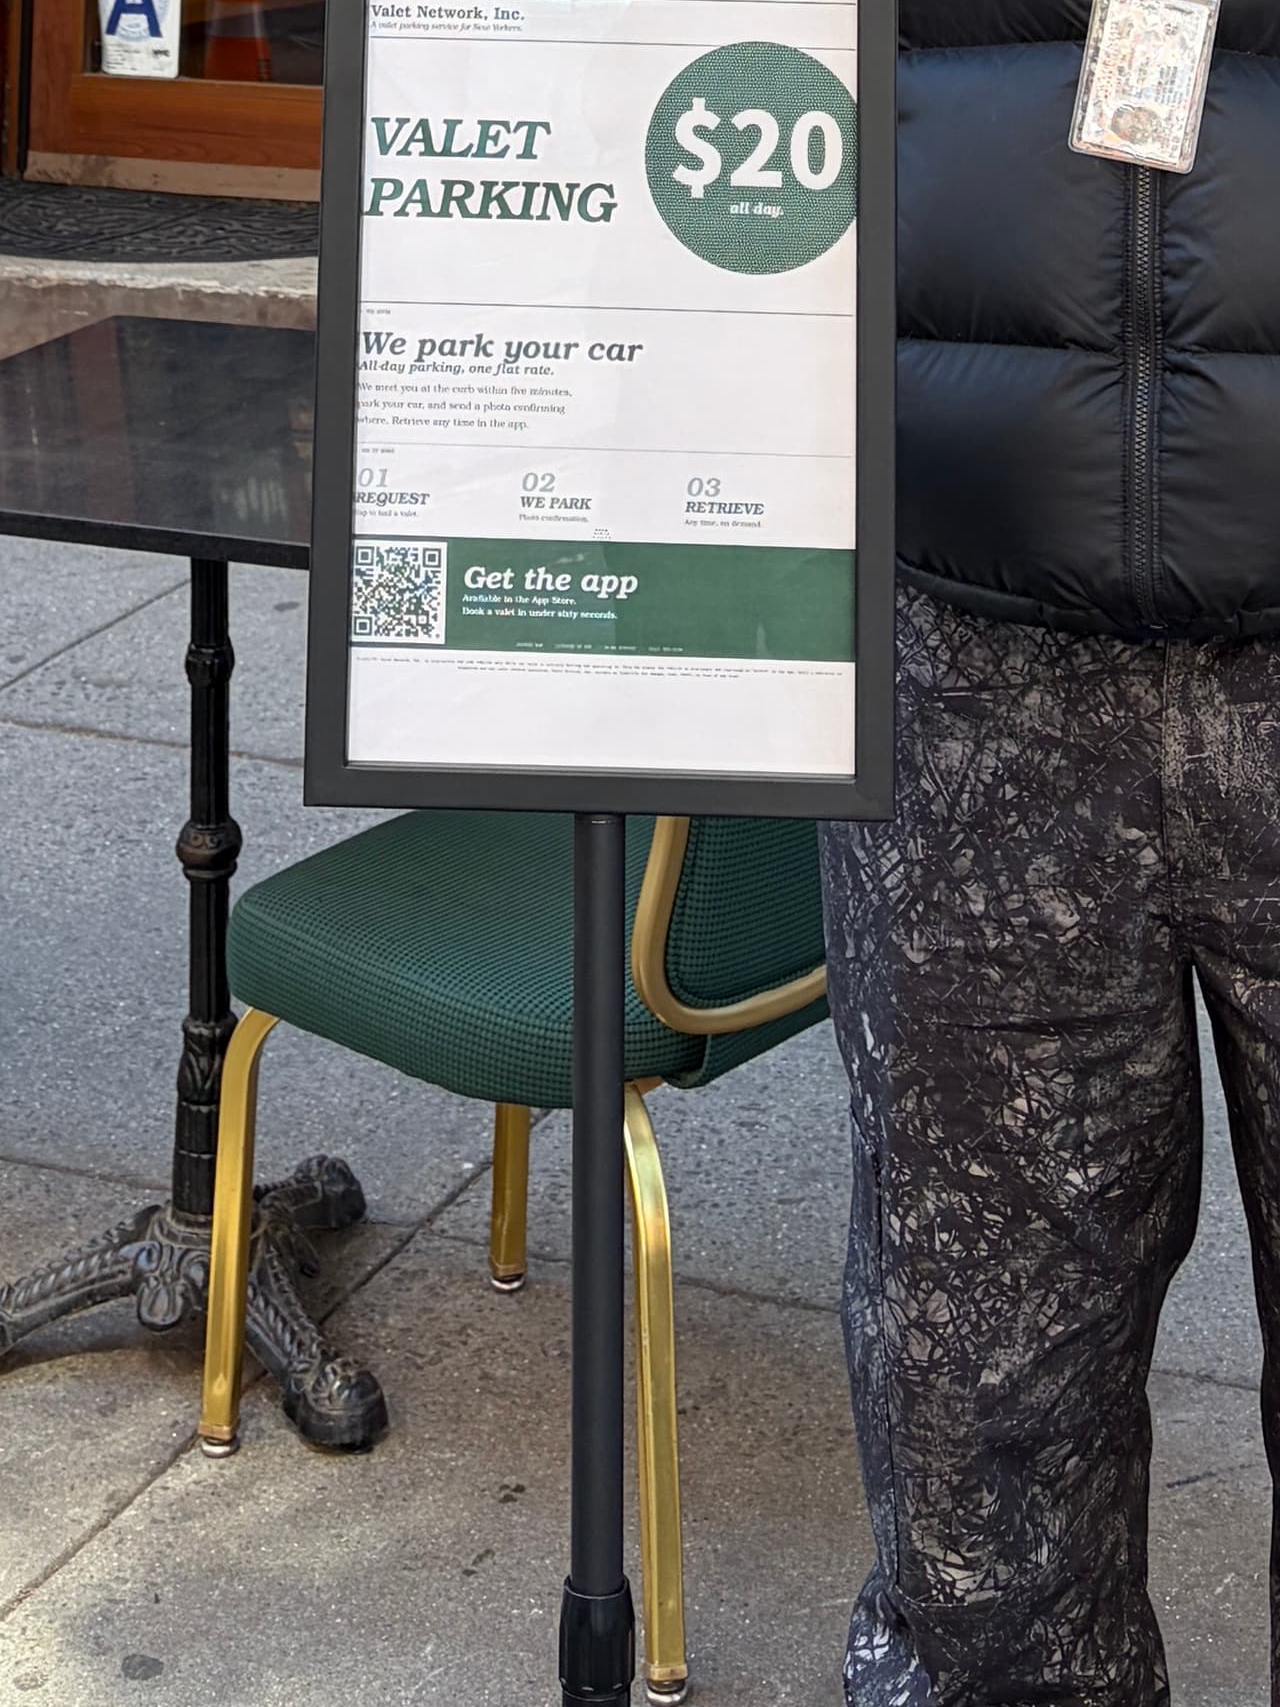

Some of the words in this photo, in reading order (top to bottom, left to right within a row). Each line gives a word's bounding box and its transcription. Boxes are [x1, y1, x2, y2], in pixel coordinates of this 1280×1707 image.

[371, 4, 412, 19] Valet
[417, 5, 489, 21] Network,
[494, 7, 525, 20] Inc.
[371, 117, 552, 160] VALET
[673, 97, 842, 199] $20
[363, 177, 618, 223] PARKING
[730, 200, 751, 216] all
[363, 331, 407, 355] We
[414, 333, 494, 363] park
[503, 339, 580, 365] your
[587, 341, 644, 362] car
[408, 362, 465, 376] parking,
[469, 364, 492, 374] one
[494, 362, 520, 377] flat
[524, 364, 555, 376] rate.
[400, 384, 418, 395] you
[433, 383, 450, 394] the
[477, 384, 507, 395] within
[510, 385, 527, 395] five
[382, 400, 404, 412] your
[426, 400, 446, 410] and
[449, 401, 471, 412] send
[483, 401, 511, 413] photo
[514, 402, 566, 416] confirming
[392, 416, 429, 427] Retrieve
[432, 418, 450, 430] any
[453, 417, 475, 428] time
[489, 418, 505, 429] the
[358, 468, 389, 488] 01
[522, 472, 556, 493] 02
[686, 477, 721, 498] 03
[354, 491, 430, 507] REQUEST
[520, 496, 546, 509] WE
[549, 497, 592, 510] PARK
[684, 501, 765, 516] RETRIEVE
[464, 566, 516, 591] Get
[524, 567, 573, 592] the
[580, 573, 639, 599] app
[531, 596, 549, 607] App
[529, 608, 555, 619] under
